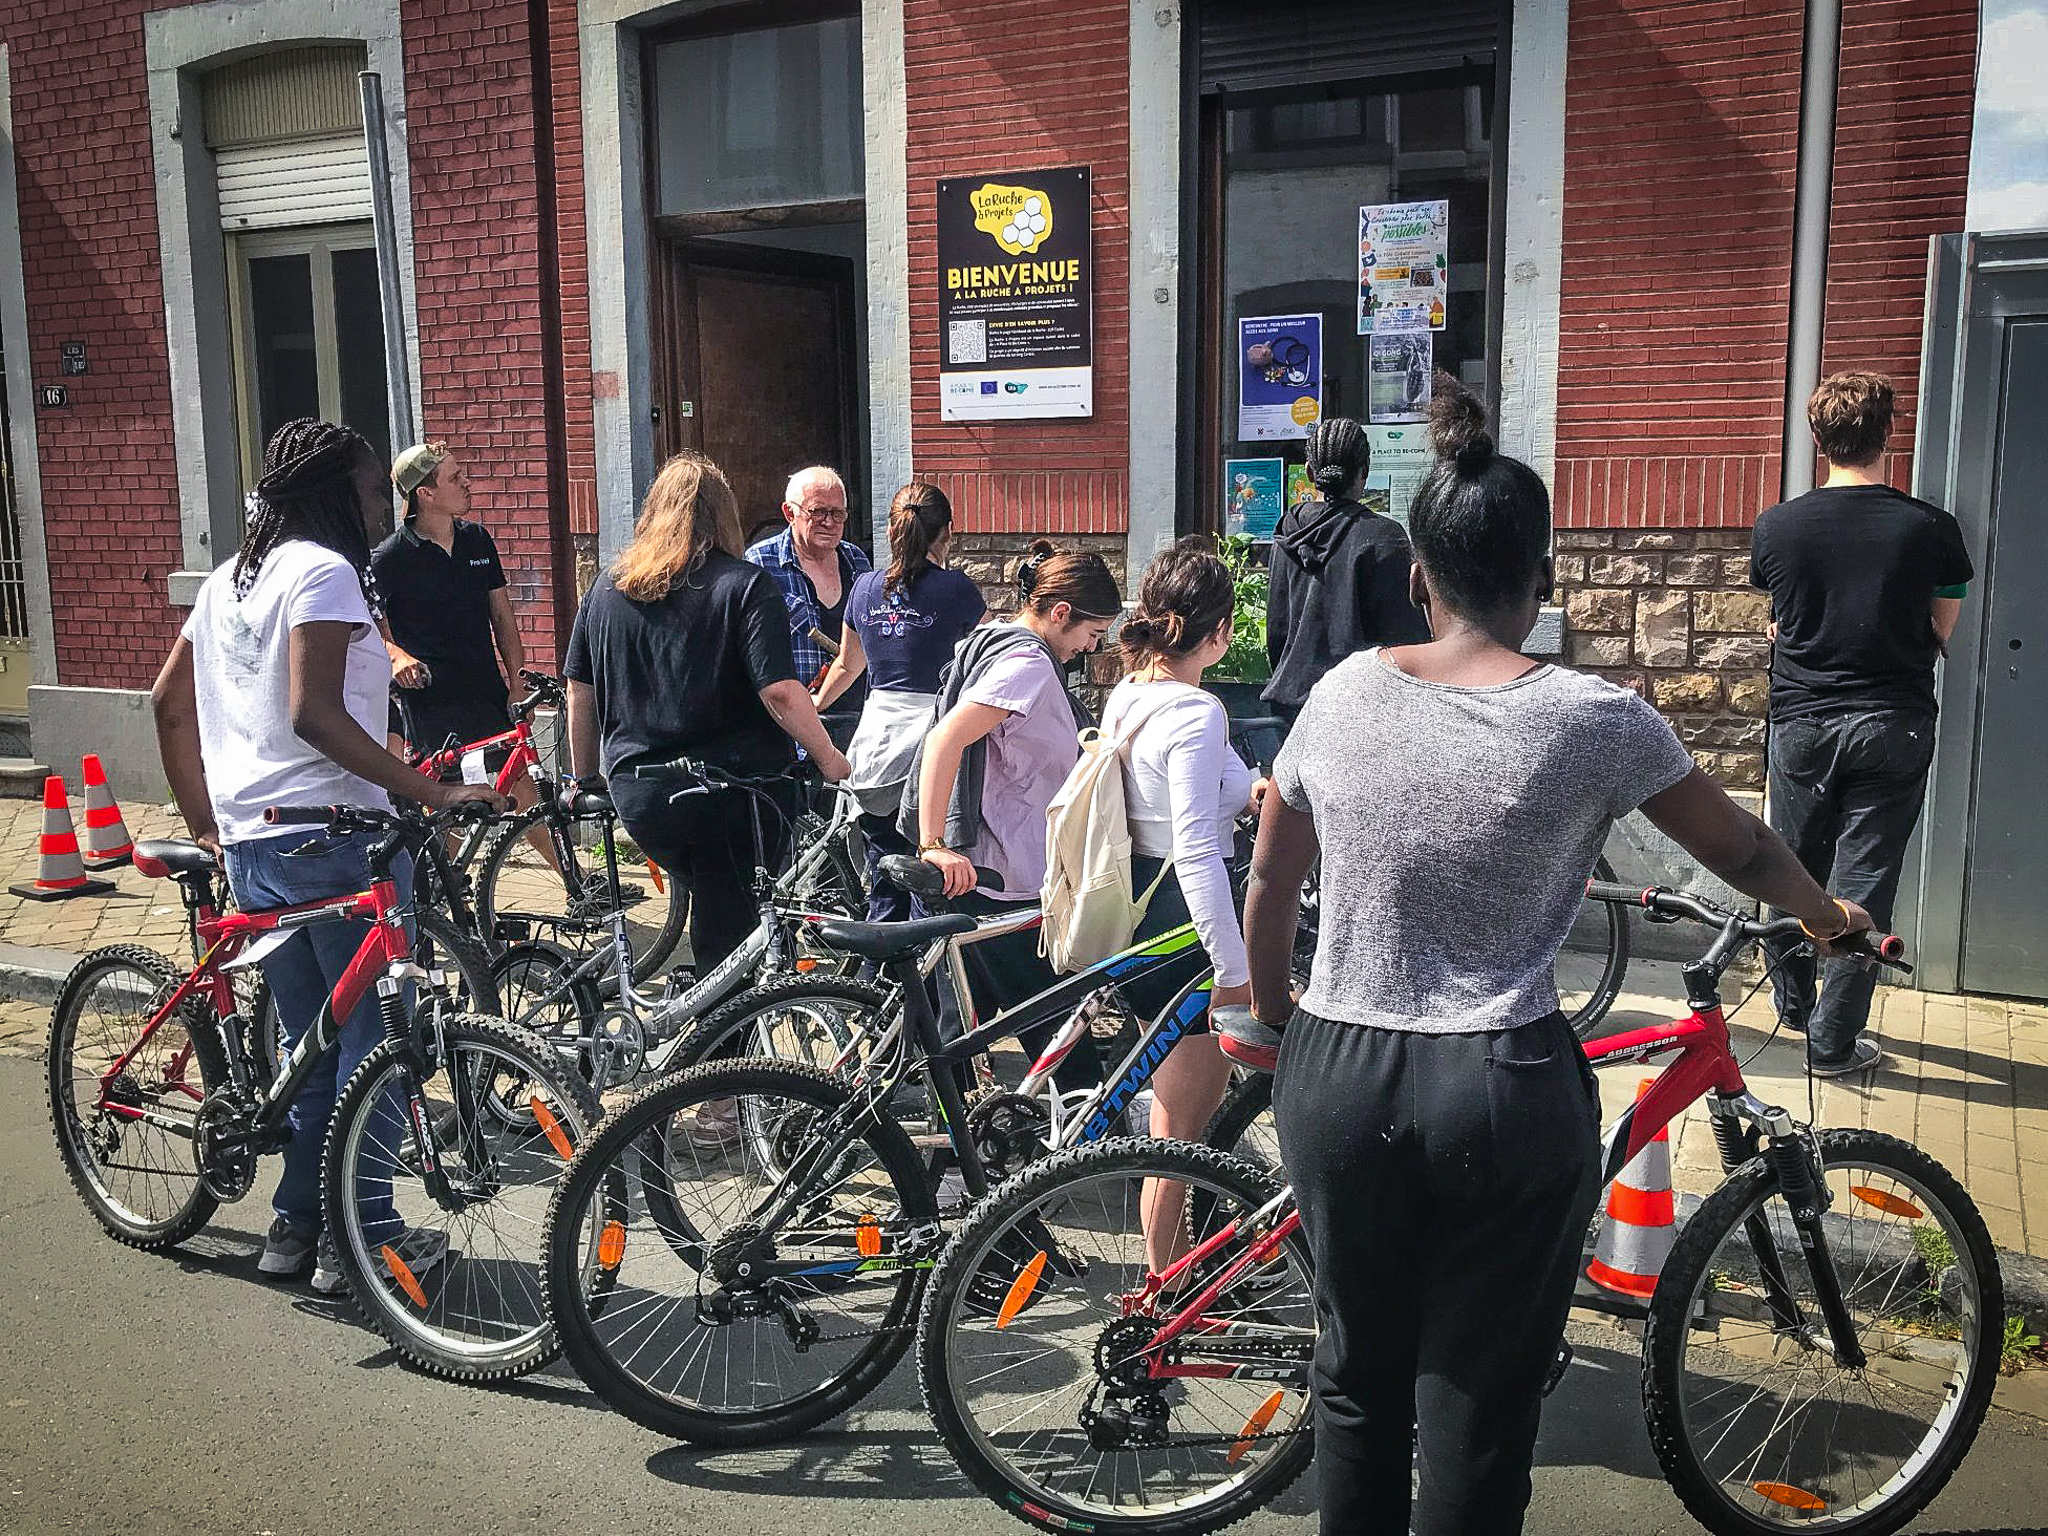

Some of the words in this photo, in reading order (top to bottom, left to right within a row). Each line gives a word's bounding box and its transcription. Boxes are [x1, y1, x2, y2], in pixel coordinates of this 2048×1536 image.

[992, 191, 1023, 206] Ruche
[985, 207, 1014, 220] Projets
[1381, 222, 1427, 243] possibles
[947, 259, 1080, 290] BIENVENUE
[964, 290, 978, 299] LA
[980, 287, 1011, 298] RUCHE
[1024, 283, 1067, 295] PROJETS
[46, 388, 60, 405] 16
[684, 943, 750, 1010] RAMBLER
[1606, 1035, 1679, 1059] AGGRESSOR
[1251, 1368, 1297, 1379] GT
